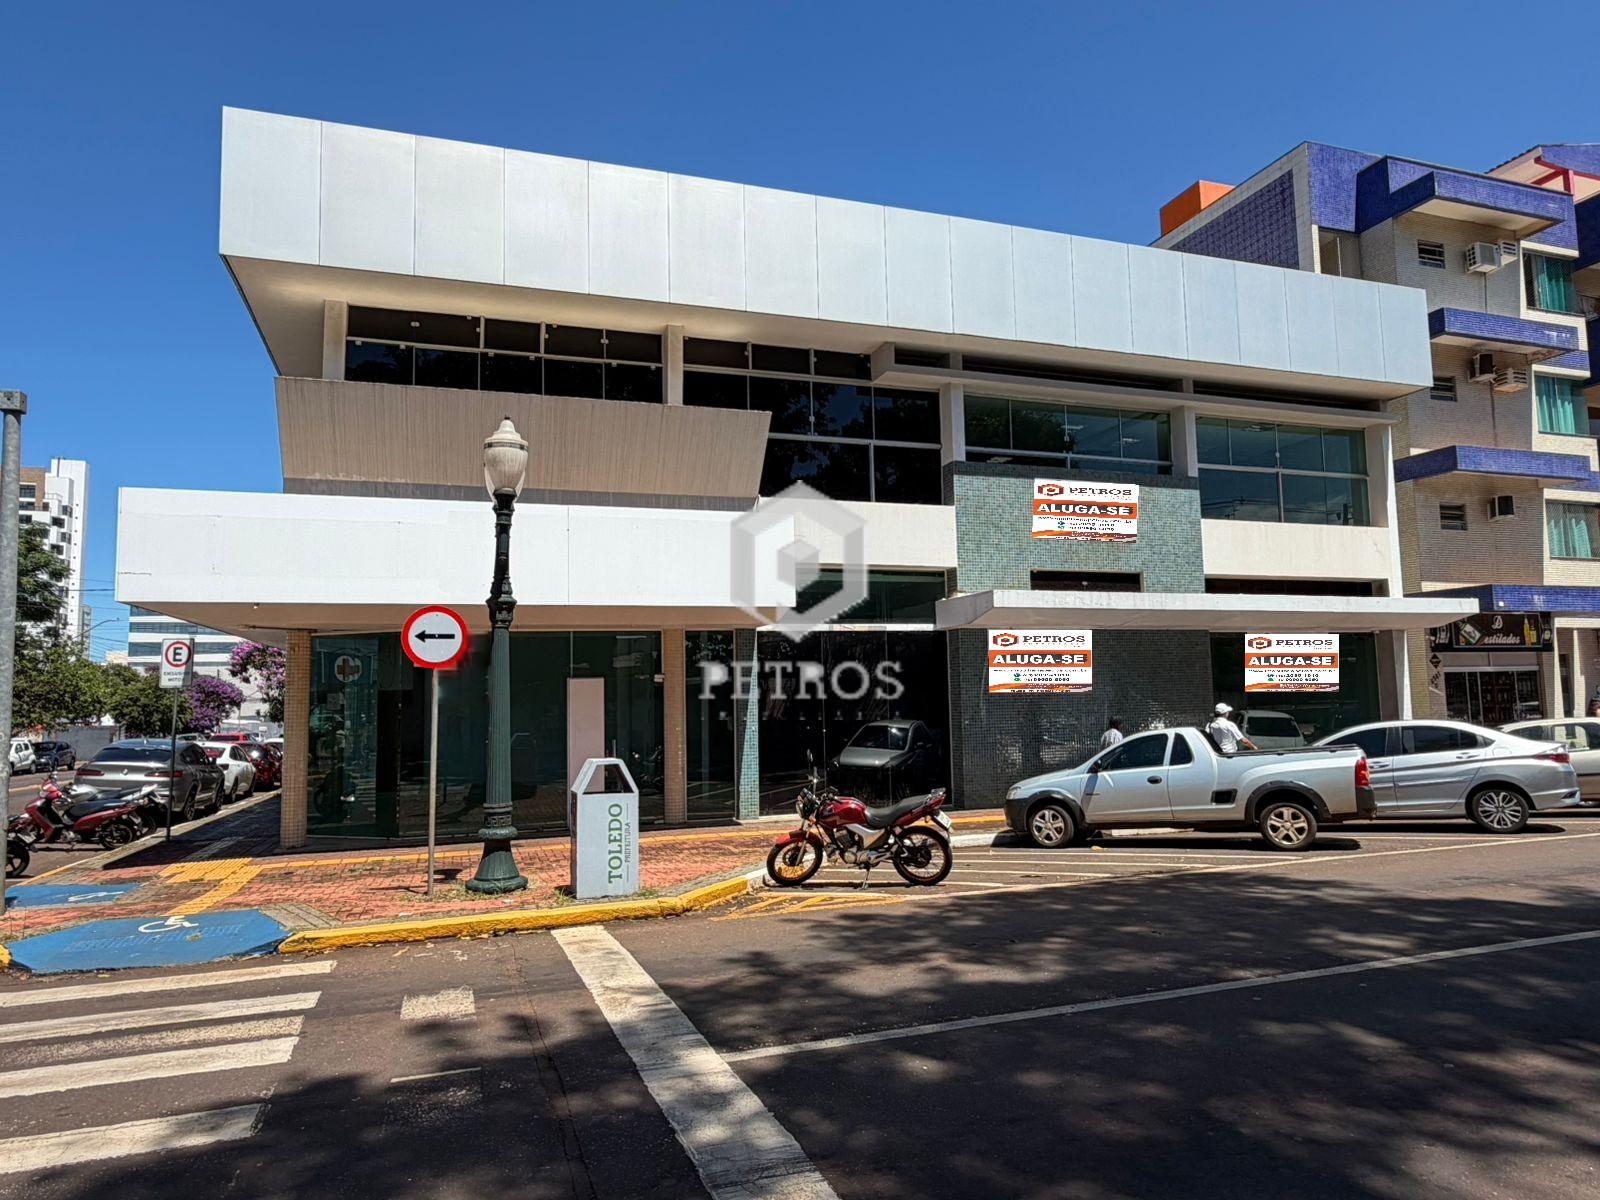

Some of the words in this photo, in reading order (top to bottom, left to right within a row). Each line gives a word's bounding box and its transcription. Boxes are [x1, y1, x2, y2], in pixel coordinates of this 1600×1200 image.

[1069, 486, 1132, 496] PETROS
[1037, 503, 1131, 516] ALUGA-SE
[1022, 635, 1086, 643] PETROS
[172, 646, 183, 662] E
[993, 654, 1085, 665] ALUGA-SE
[1248, 656, 1333, 666] ALUGA-SE
[608, 803, 623, 884] TOLEDO
[624, 822, 632, 863] PREFEITURA
